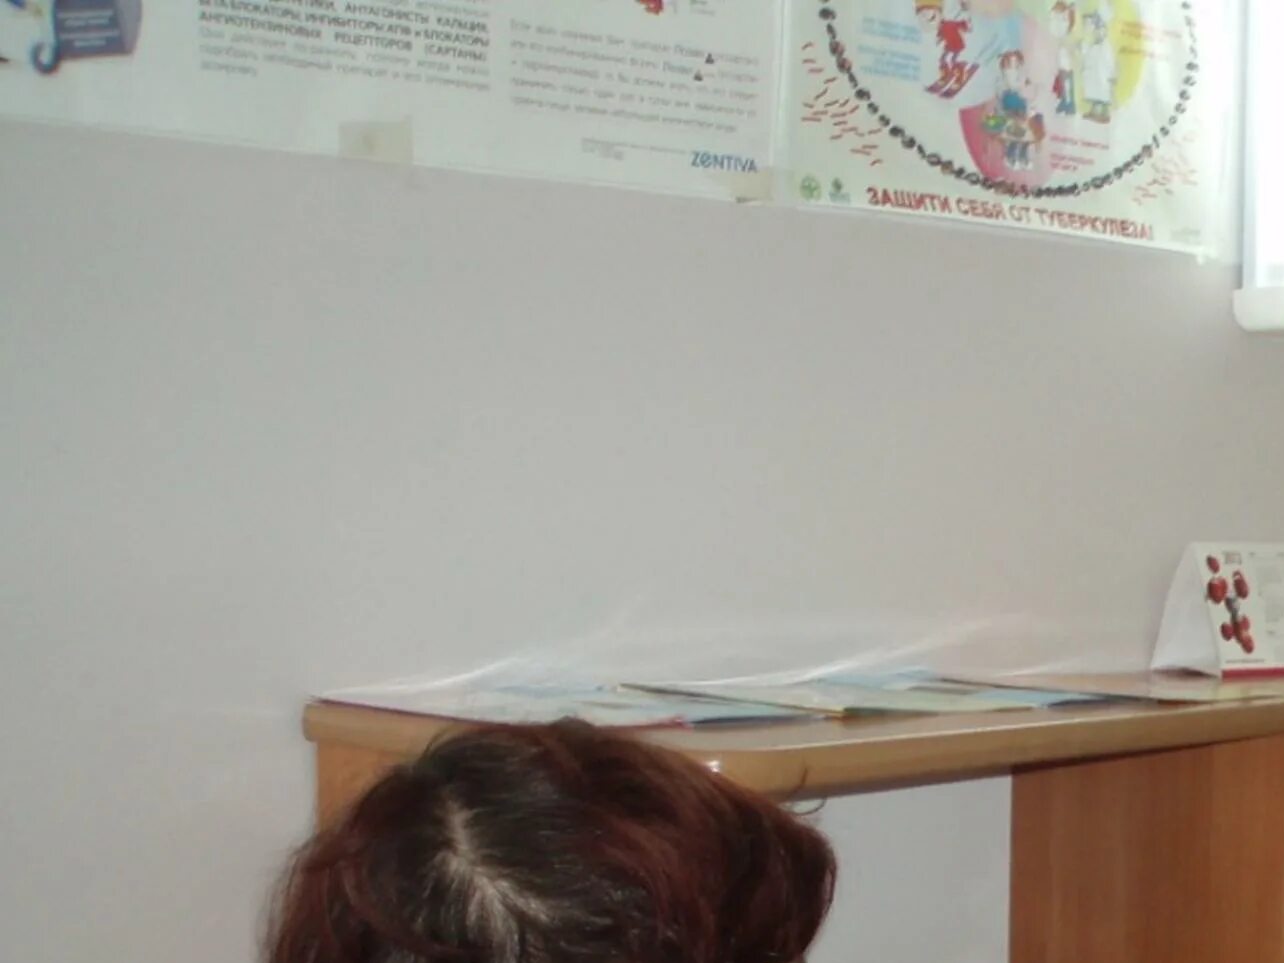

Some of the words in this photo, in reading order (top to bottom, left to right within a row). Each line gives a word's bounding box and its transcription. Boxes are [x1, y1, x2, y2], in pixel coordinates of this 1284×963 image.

[333, 31, 413, 51] РЕЦЕПТОРОВ
[866, 186, 952, 214] ЗАЩИТИ
[955, 197, 1007, 221] СЕБЯ
[1009, 204, 1032, 224] ОТ
